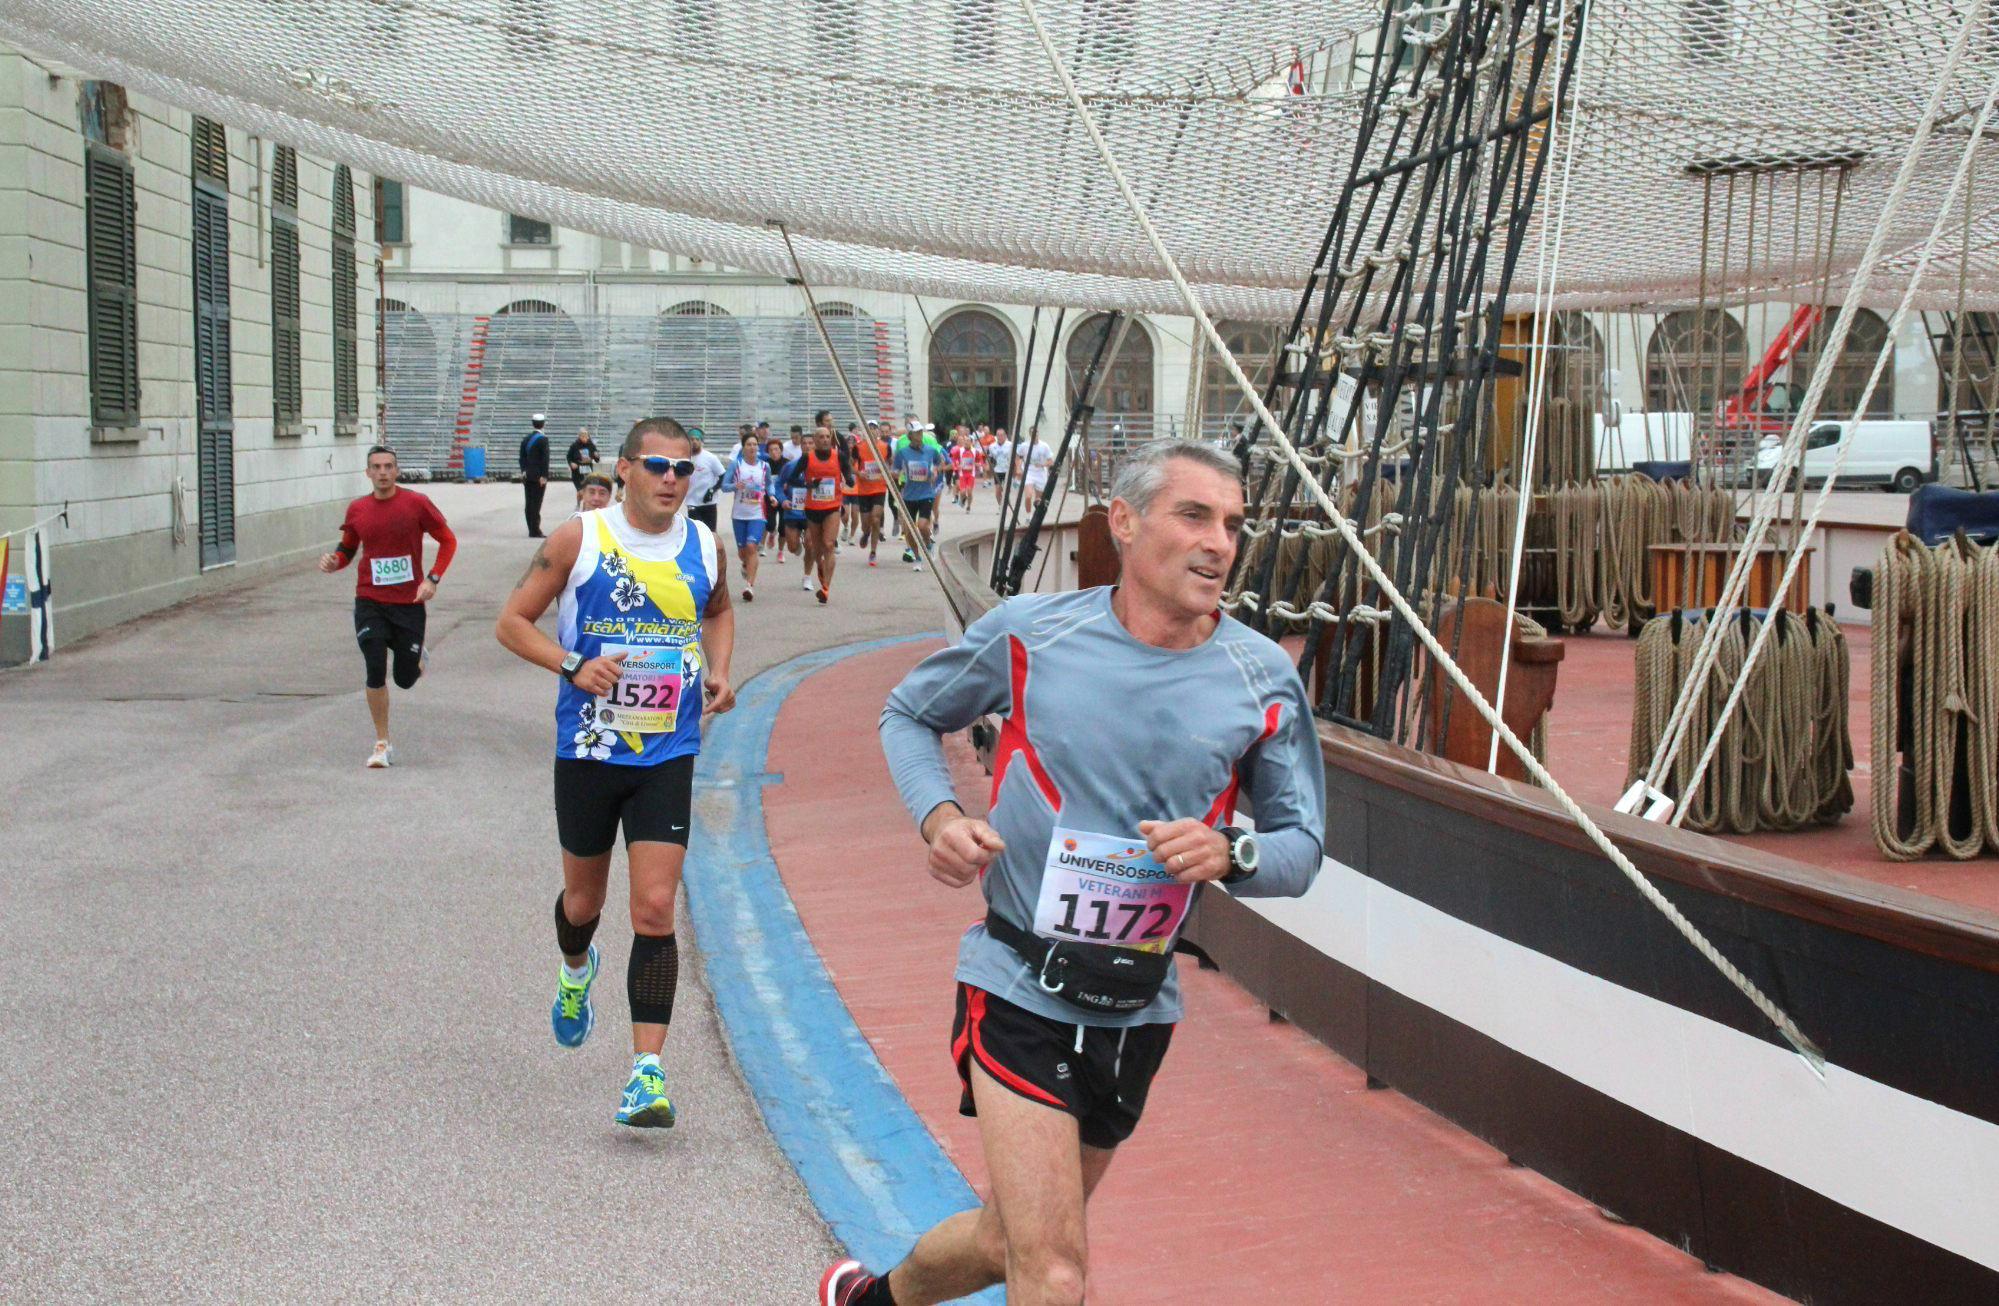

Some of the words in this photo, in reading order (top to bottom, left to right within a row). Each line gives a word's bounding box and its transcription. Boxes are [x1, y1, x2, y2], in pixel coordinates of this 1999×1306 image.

[376, 558, 408, 575] 3680
[606, 681, 674, 709] 1522
[1059, 852, 1176, 879] UNIVERSOSPOR
[1078, 876, 1148, 900] VETERANI
[1053, 893, 1173, 941] 1172
[1077, 991, 1100, 1004] ING
